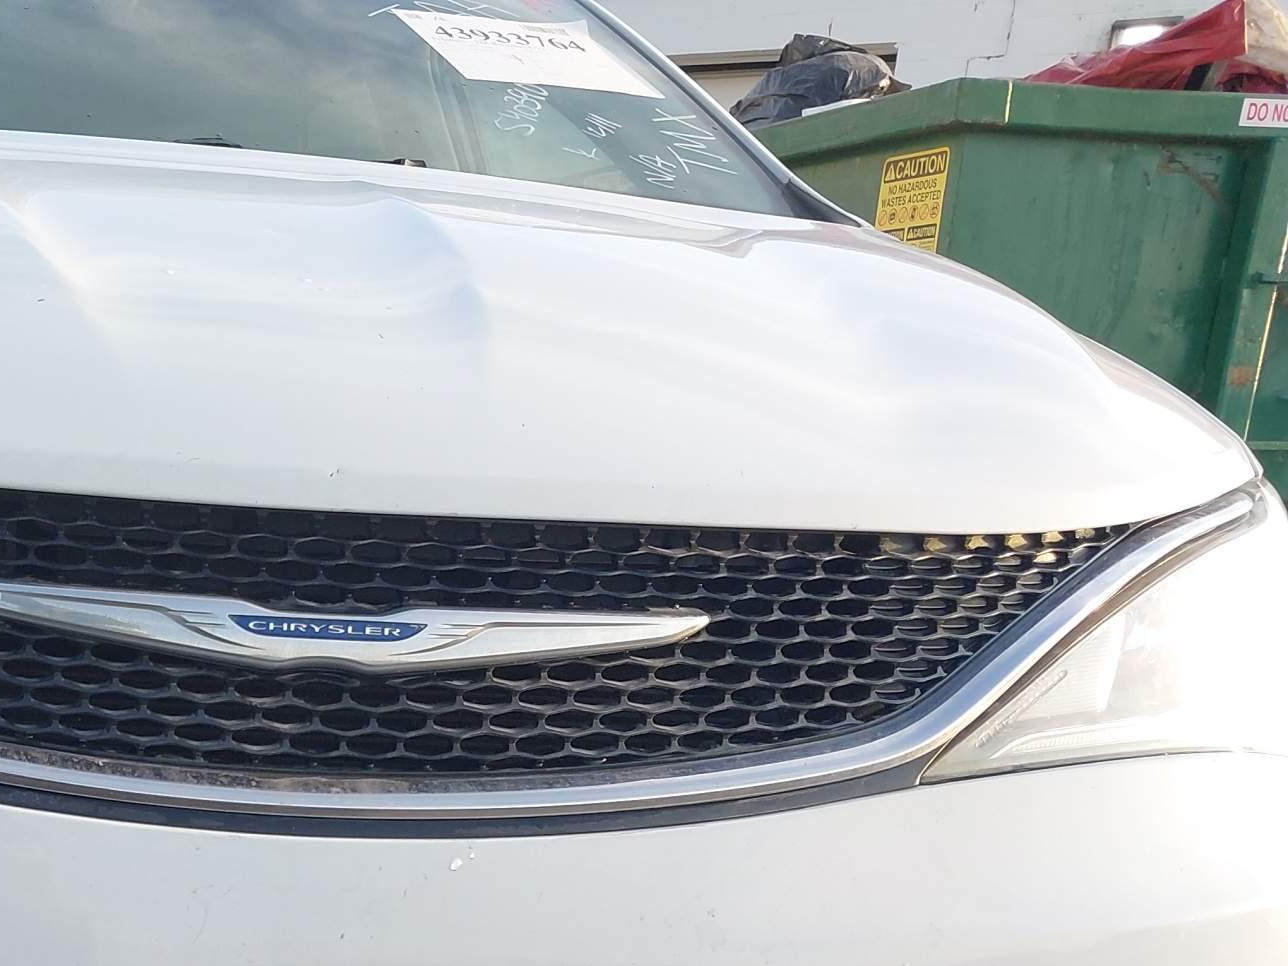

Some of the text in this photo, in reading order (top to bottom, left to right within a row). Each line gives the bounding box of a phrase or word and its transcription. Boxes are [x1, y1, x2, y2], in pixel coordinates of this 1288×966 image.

[434, 24, 587, 53] 43933764
[1246, 102, 1269, 122] DO
[895, 153, 946, 180] CAUTION
[888, 178, 938, 196] NO HAZARDOUS
[881, 189, 942, 209] WASTES ACCEPTED
[247, 620, 401, 637] CHRYSLER
